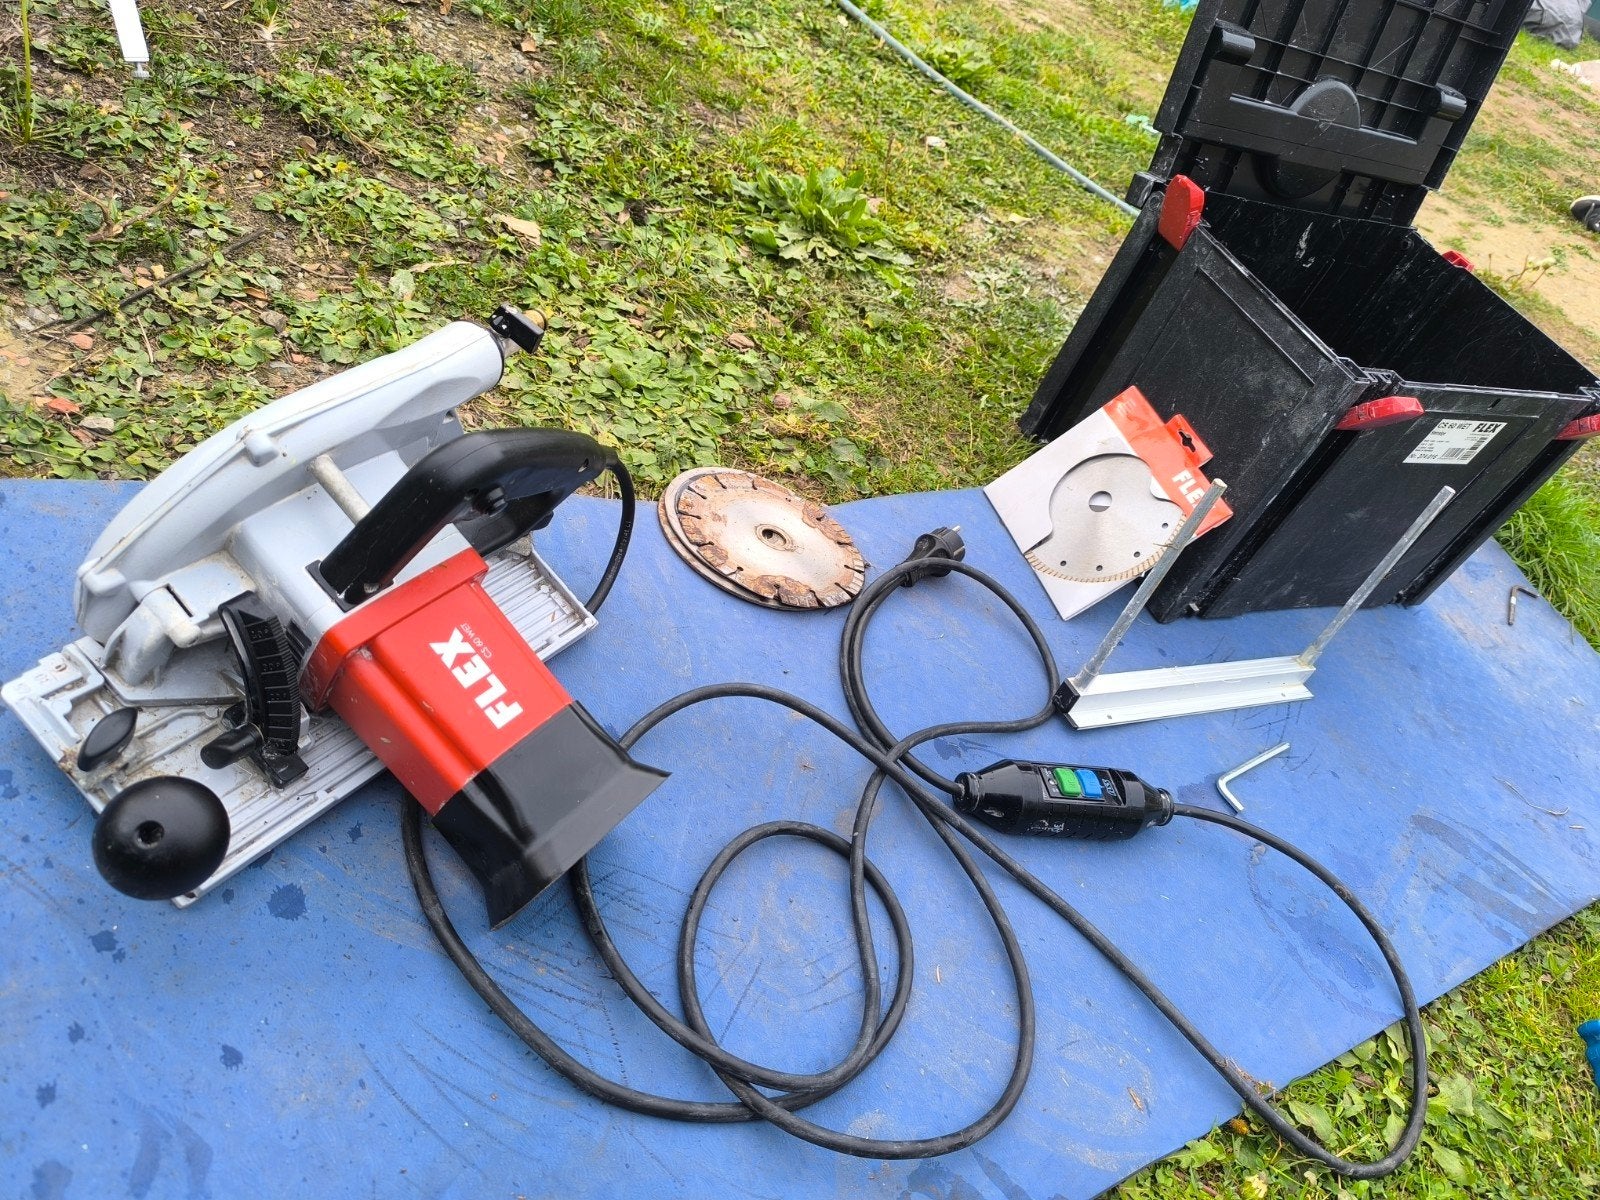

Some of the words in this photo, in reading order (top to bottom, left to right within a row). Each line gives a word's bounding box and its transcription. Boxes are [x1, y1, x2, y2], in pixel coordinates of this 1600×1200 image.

[1472, 422, 1503, 433] FLEX
[1171, 469, 1213, 508] FLE
[460, 622, 475, 639] WET
[473, 637, 483, 647] 60
[481, 646, 492, 659] CS
[428, 627, 524, 730] FLEX
